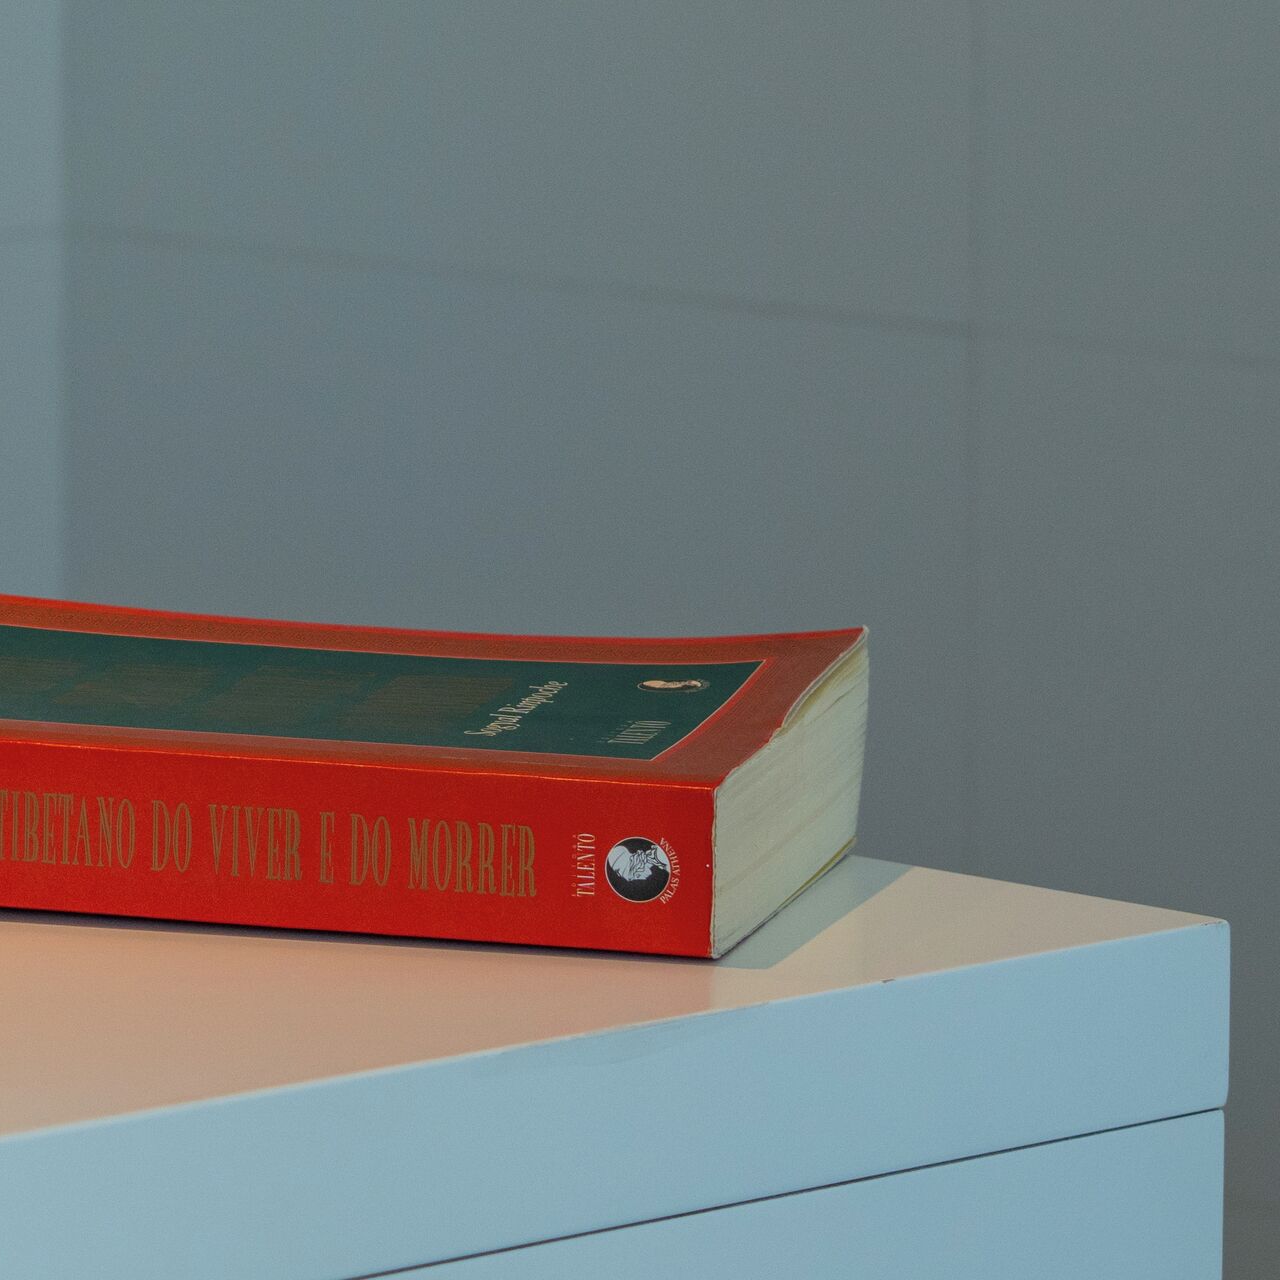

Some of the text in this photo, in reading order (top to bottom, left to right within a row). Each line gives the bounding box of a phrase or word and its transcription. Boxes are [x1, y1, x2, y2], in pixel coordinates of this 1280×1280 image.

[150, 798, 192, 874] DO
[208, 803, 303, 881] VIVER
[318, 811, 337, 884] E
[349, 812, 392, 887] DO
[407, 817, 537, 897] MORRER
[577, 833, 596, 898] TALENTO
[660, 837, 681, 904] PALAS ATHENA
